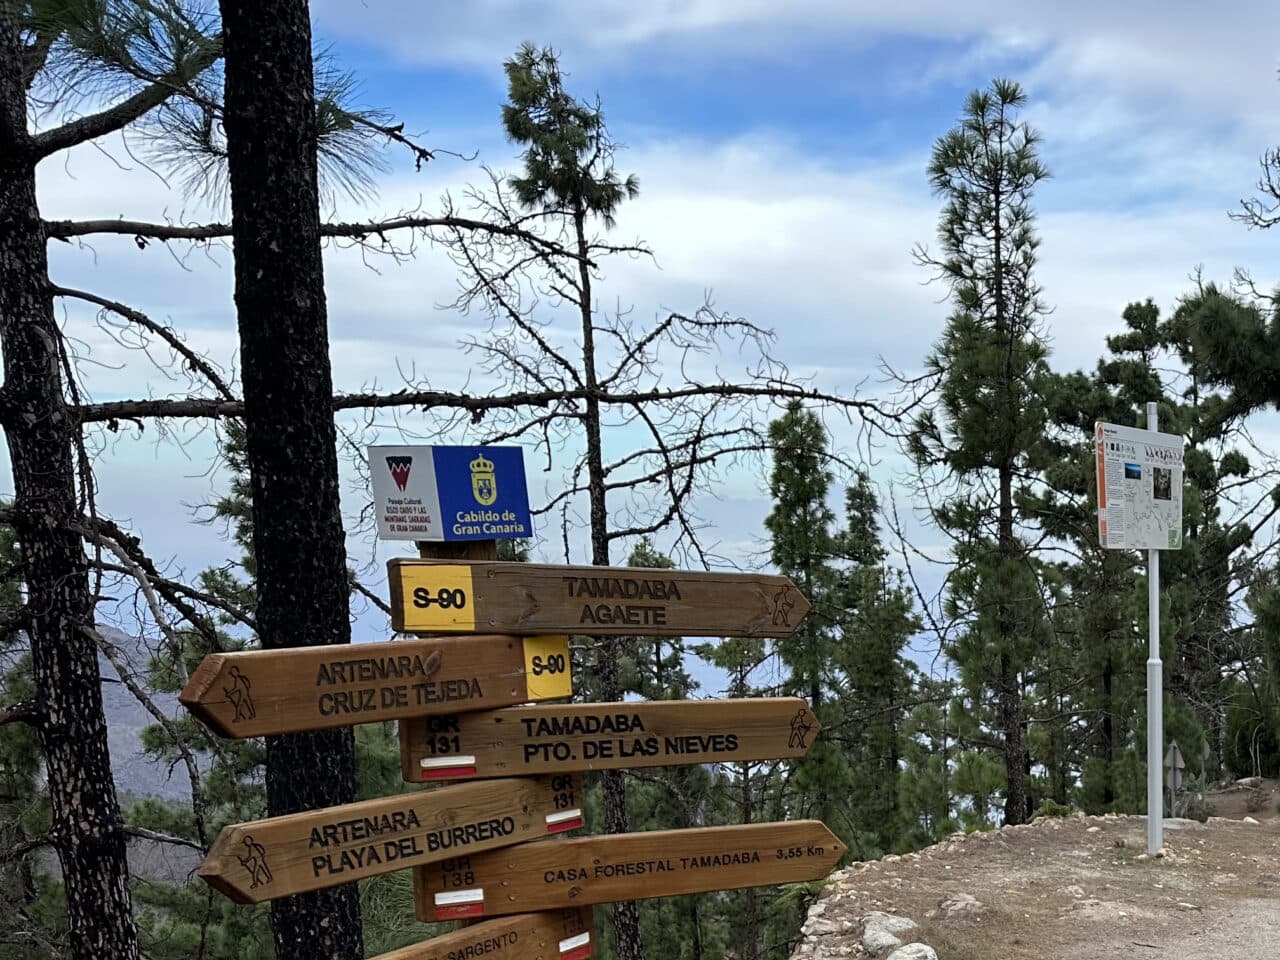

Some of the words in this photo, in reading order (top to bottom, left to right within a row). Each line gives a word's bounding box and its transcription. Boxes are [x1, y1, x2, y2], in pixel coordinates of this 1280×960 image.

[456, 510, 499, 523] Cabildo
[502, 510, 516, 521] de
[453, 524, 481, 535] Gran
[483, 522, 525, 534] Canaria
[413, 587, 466, 610] S-90
[562, 576, 681, 600] TAMADABA
[580, 604, 667, 625] AGAETE
[316, 655, 426, 686] ARTENARA
[532, 654, 565, 676] S-90
[318, 688, 377, 716] CRUZ
[380, 685, 409, 709] DE
[411, 678, 483, 705] TEJEDA
[427, 715, 460, 732] GR
[520, 714, 645, 737] TAMADABA
[427, 736, 460, 754] 131
[524, 742, 577, 764] PTO.
[583, 739, 613, 760] DE
[619, 737, 660, 758] LAS
[664, 734, 739, 756] NIEVES
[552, 774, 574, 792] GR
[553, 792, 575, 809] 131
[308, 808, 421, 849] ARTENARA
[312, 844, 382, 877] PLAYA
[385, 837, 424, 861] DEL
[426, 816, 515, 852] BURRERO
[544, 868, 588, 884] CASA
[594, 860, 676, 880] FORESTAL
[680, 851, 760, 870] TAMADABA
[806, 845, 825, 858] Km
[442, 872, 474, 888] 138
